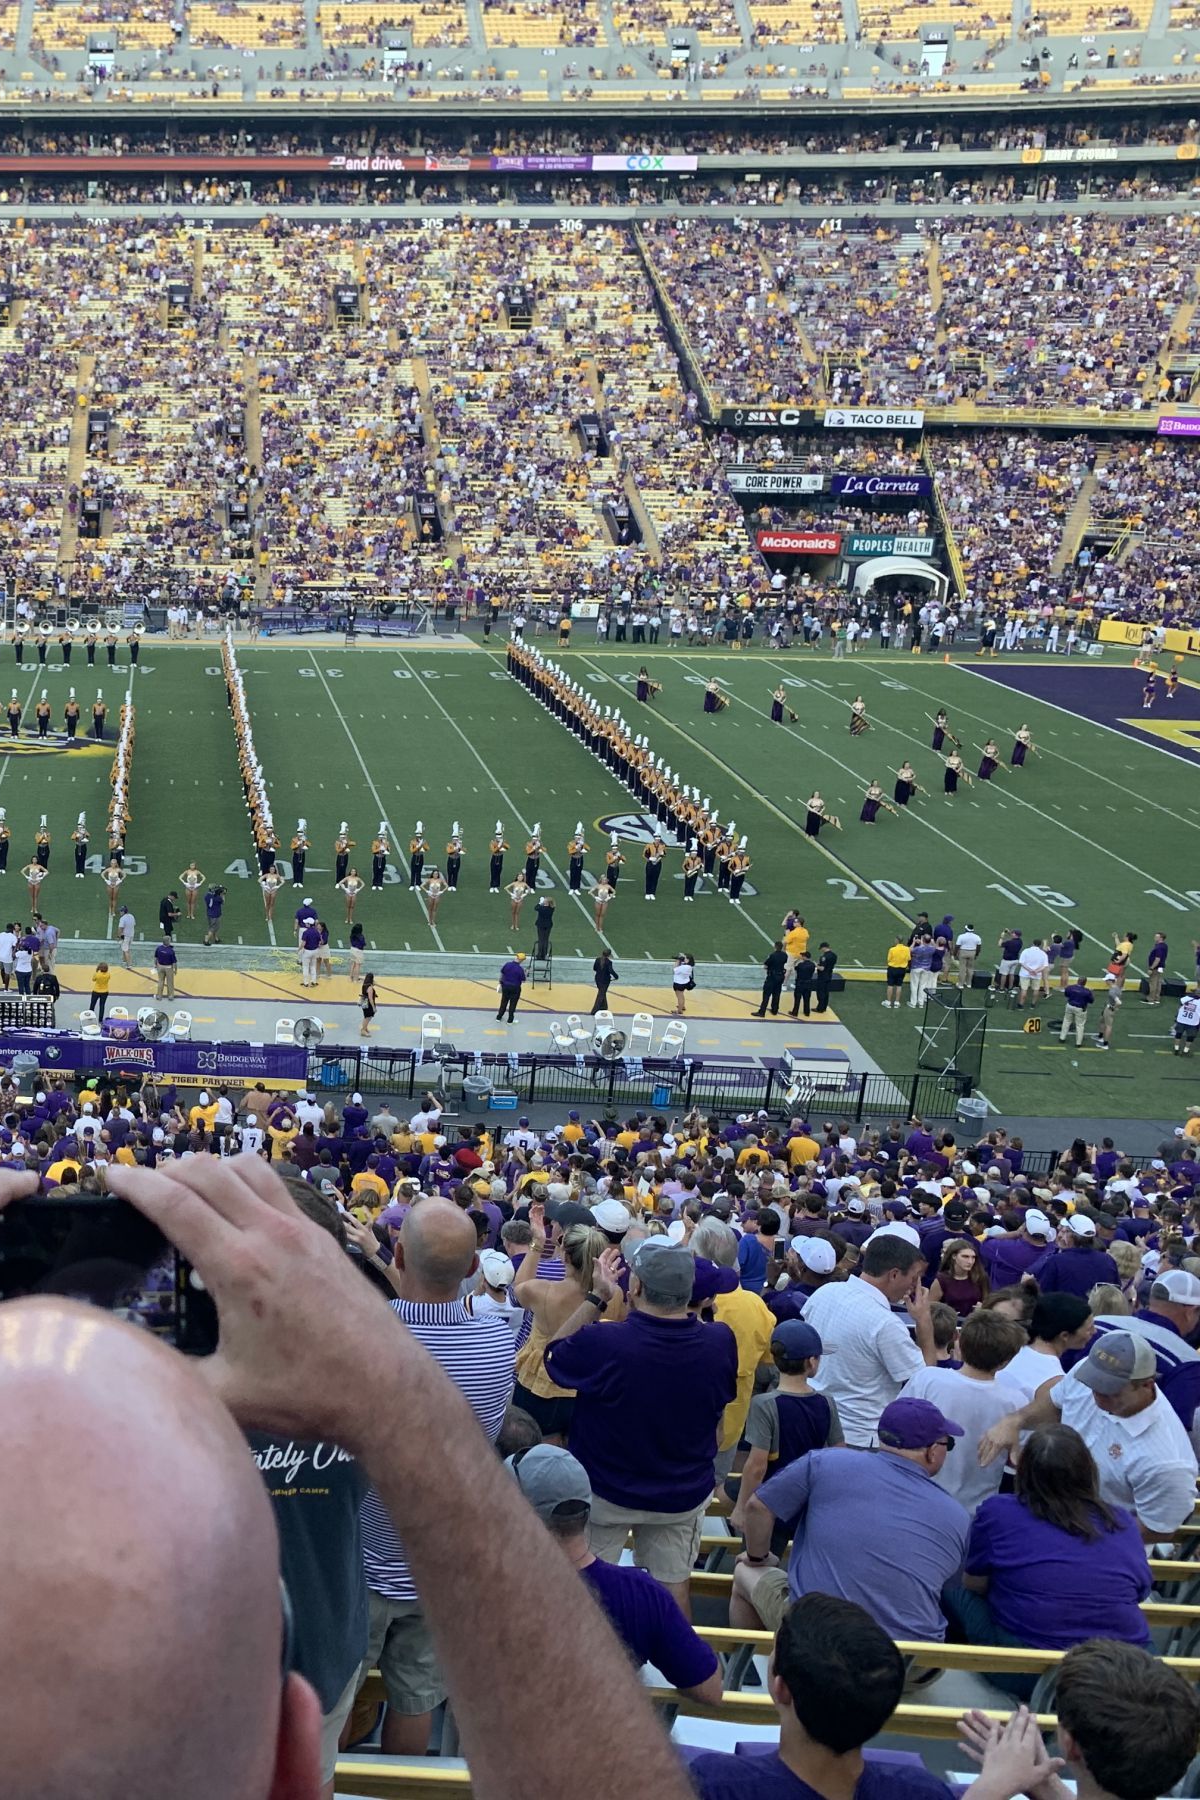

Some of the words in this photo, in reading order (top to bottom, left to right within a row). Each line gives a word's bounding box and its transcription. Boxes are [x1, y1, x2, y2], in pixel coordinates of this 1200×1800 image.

[346, 157, 369, 170] and
[371, 157, 405, 170] drive.
[626, 156, 664, 169] COX
[420, 218, 444, 229] 305
[560, 219, 583, 231] 306
[851, 414, 884, 424] TACO
[886, 415, 917, 425] BELL
[745, 476, 769, 488] CORE
[770, 476, 803, 488] POWER
[841, 477, 864, 494] La
[865, 477, 920, 494] Carreta
[761, 537, 837, 550] McDonald's
[853, 539, 893, 552] PEOPLES
[896, 540, 931, 552] HEALTH
[825, 877, 915, 902] 20
[985, 883, 1077, 908] 15
[1029, 1018, 1041, 1033] 20
[217, 1053, 268, 1064] BRIDGEWAY
[171, 1076, 198, 1084] TIGER
[202, 1078, 245, 1087] PARTNER
[249, 1137, 257, 1148] 7
